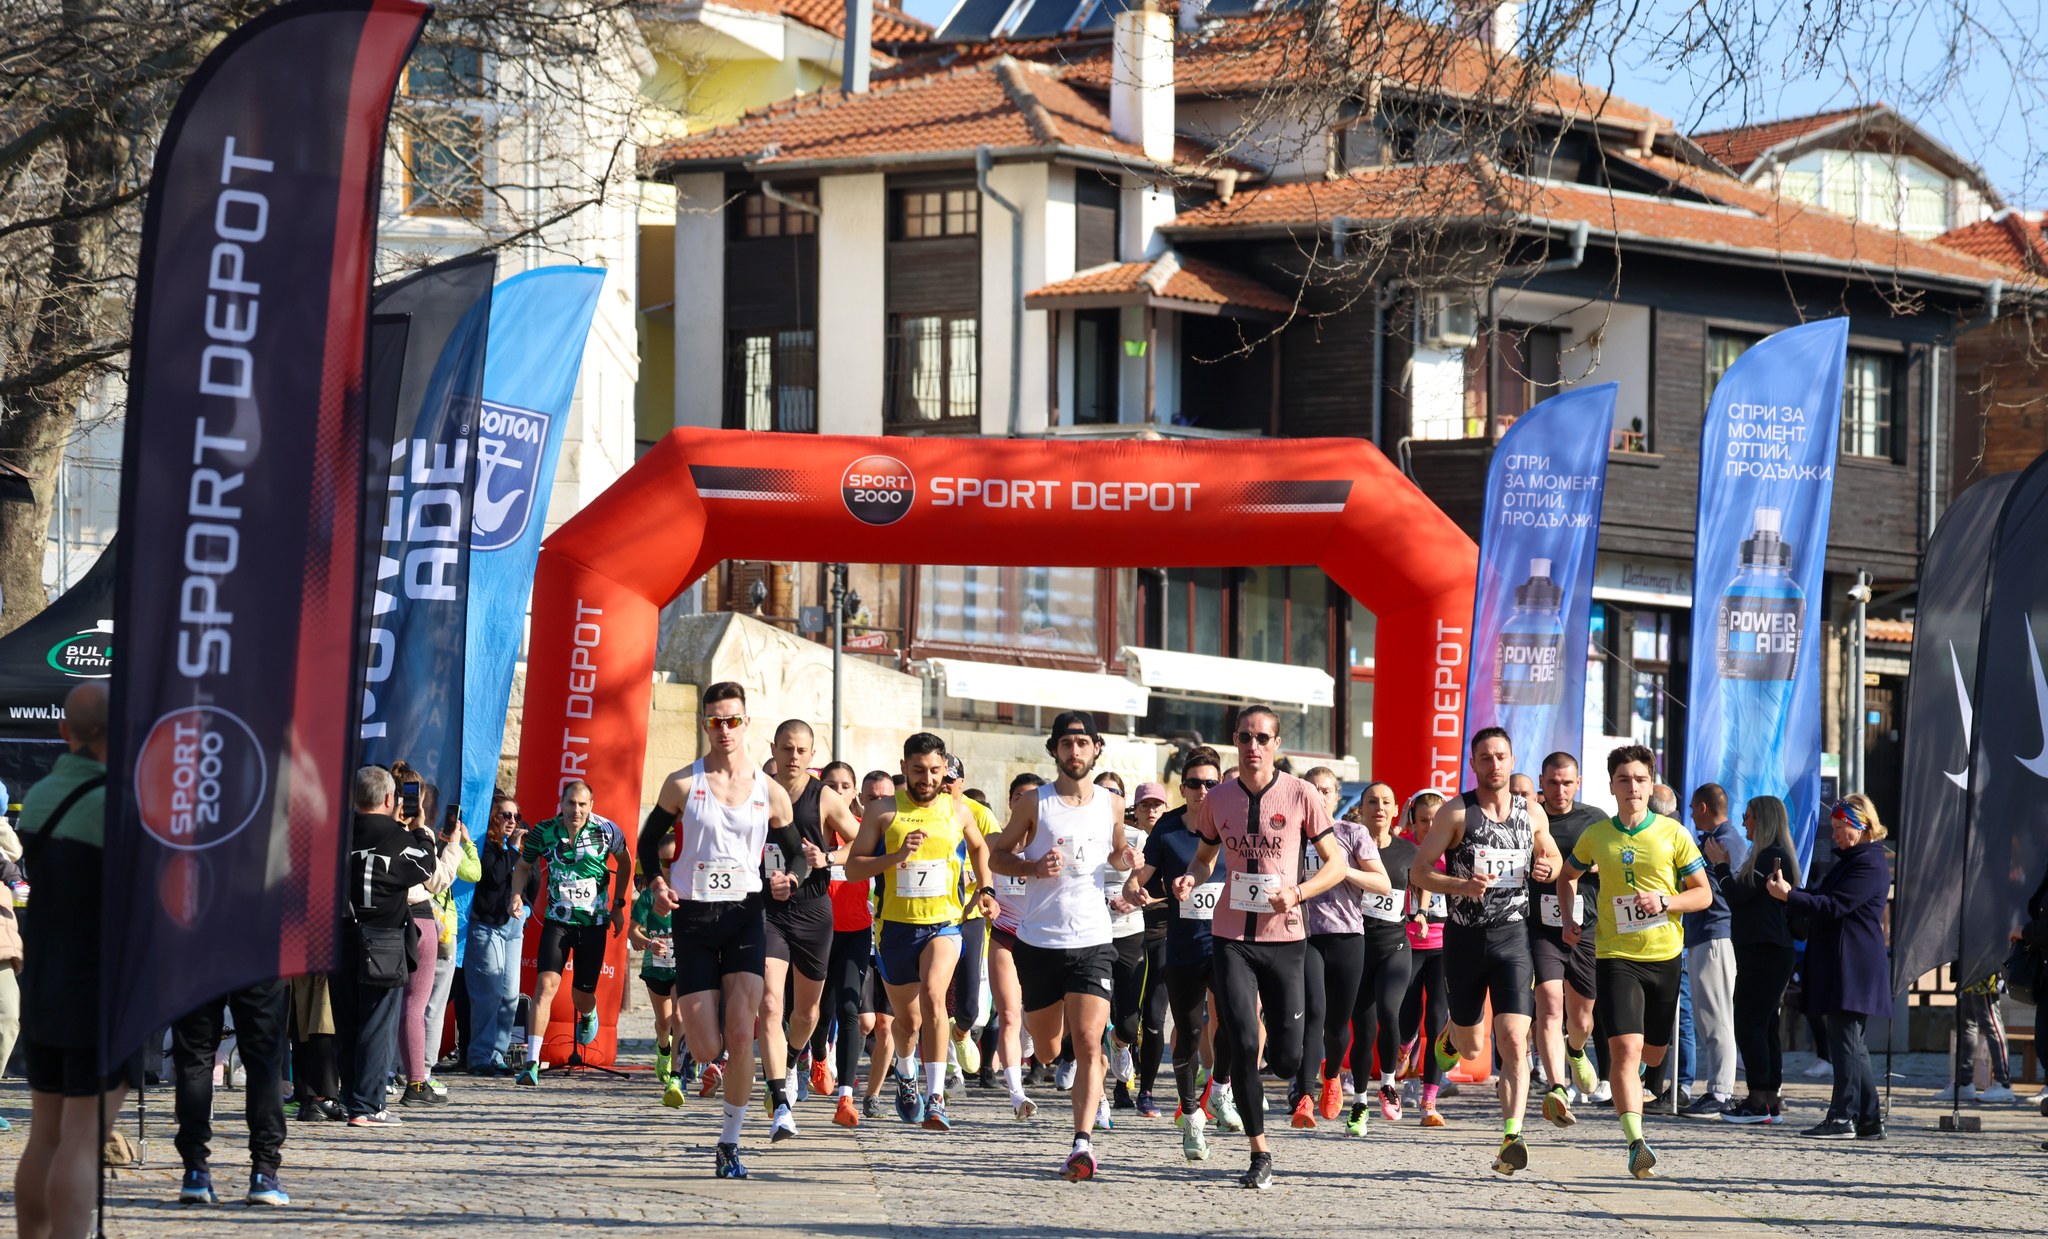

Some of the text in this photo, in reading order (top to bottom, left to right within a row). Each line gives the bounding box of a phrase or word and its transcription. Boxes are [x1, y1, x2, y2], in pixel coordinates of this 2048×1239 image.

[177, 136, 274, 678] SPORT DEPOT
[1727, 403, 1804, 423] СПРИ ЗА
[1728, 422, 1806, 442] МОМЕНТ.
[1727, 441, 1791, 460] ОТПИЙ.
[1505, 454, 1550, 470] СПРИ
[1726, 461, 1832, 481] ПРОДЪЛЖИ.
[848, 474, 908, 488] SPORT
[1504, 473, 1603, 491] ЗА МОМЕНТ.
[854, 489, 902, 504] 2000
[930, 477, 1200, 511] SPORT DEPOT
[1503, 490, 1565, 509] ОТПИЙ.
[404, 438, 468, 601] ADE
[1501, 511, 1598, 528] ПРОДЪЛЖИ.
[1729, 611, 1797, 633] POWER
[66, 645, 102, 657] BUL
[1756, 632, 1796, 654] ADE
[566, 599, 603, 719] DEPOT
[1504, 646, 1557, 664] POWER
[1432, 619, 1464, 738] DEPOT
[1529, 663, 1555, 682] ADE
[170, 721, 199, 836] SPORT
[196, 731, 225, 824] 2000
[1225, 834, 1282, 852] QATAR
[1076, 846, 1085, 862] 4
[1238, 849, 1282, 859] AIRWAYS
[1486, 860, 1515, 877] 191
[708, 873, 732, 889] 33
[917, 871, 928, 886] 7
[568, 889, 591, 900] 156
[1193, 893, 1215, 909] 30
[1248, 885, 1259, 901] 9
[1373, 895, 1394, 911] 28
